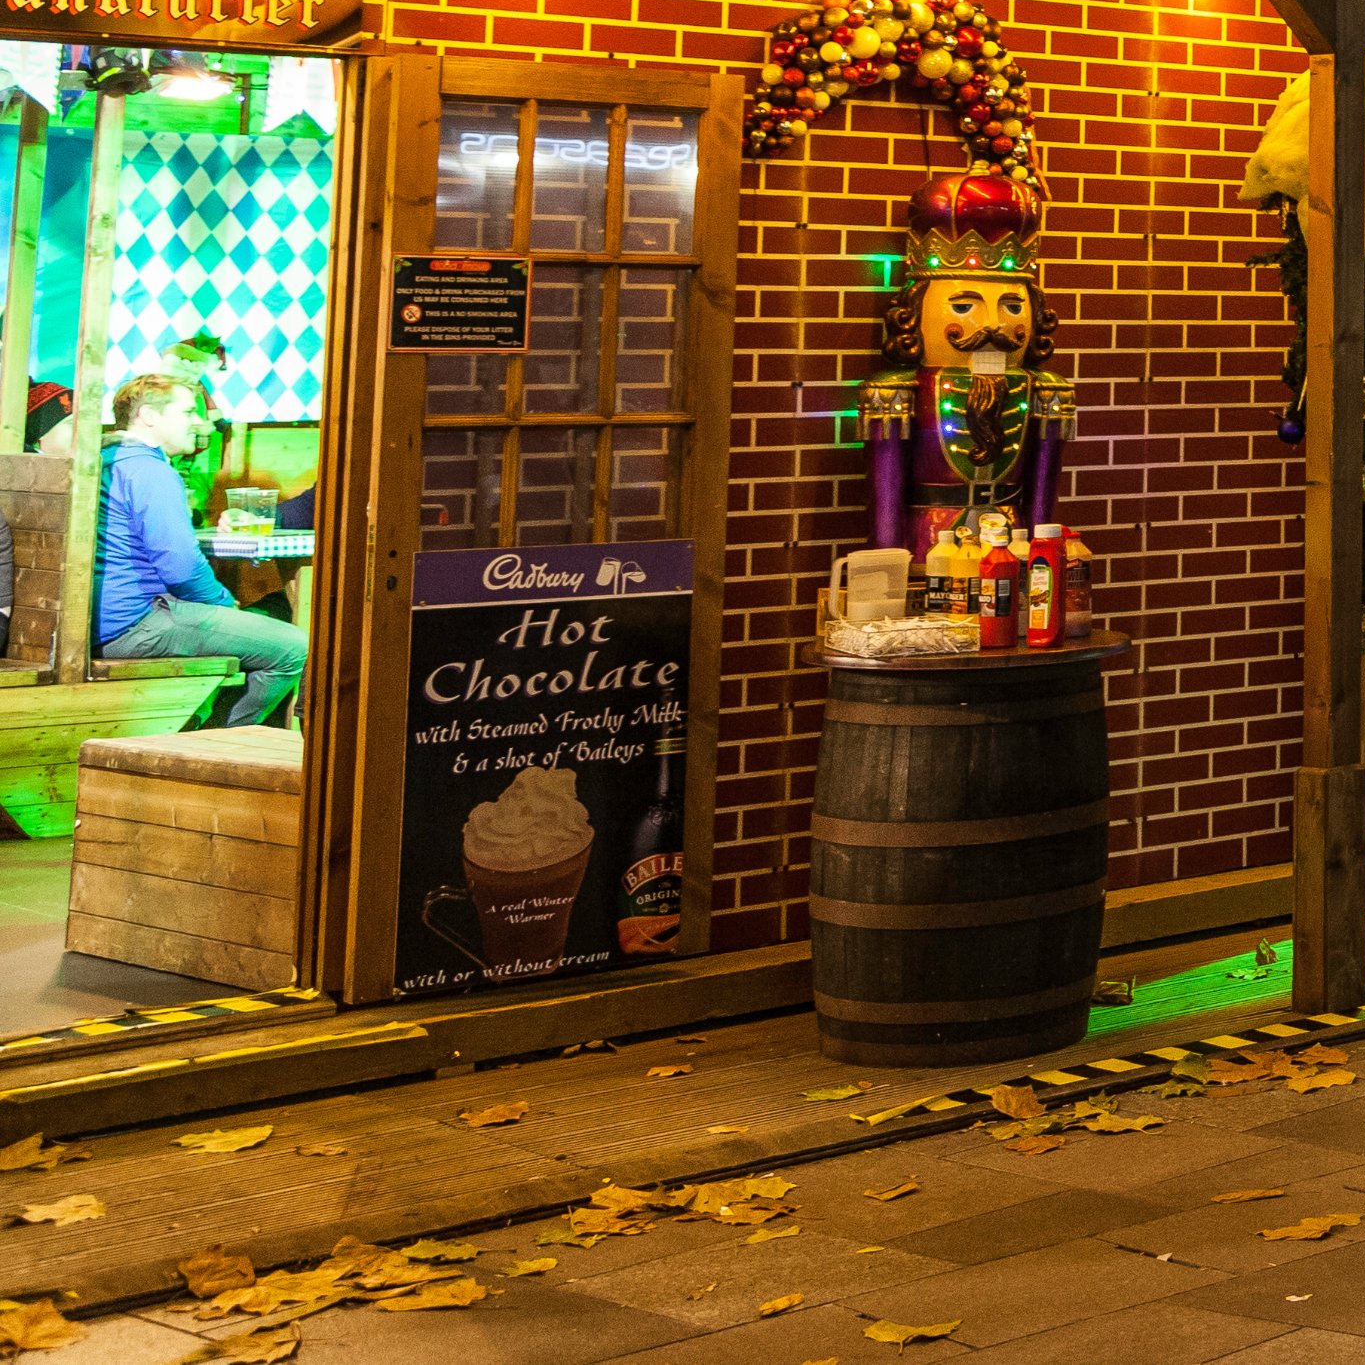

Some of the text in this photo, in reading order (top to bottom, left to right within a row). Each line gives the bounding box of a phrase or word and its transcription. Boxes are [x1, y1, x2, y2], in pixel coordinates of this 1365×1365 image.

[482, 553, 585, 593] Cadbury
[497, 608, 615, 650] Hot
[423, 650, 680, 704] Chocolate
[415, 701, 688, 745] with Steamed Frothy Milk
[453, 737, 646, 774] & a shot of Baileys
[626, 856, 684, 888] BAILE
[485, 896, 576, 914] A real Winter
[636, 889, 680, 905] ORIGIN
[504, 913, 556, 924] Warmer
[404, 951, 611, 989] with or without cream
